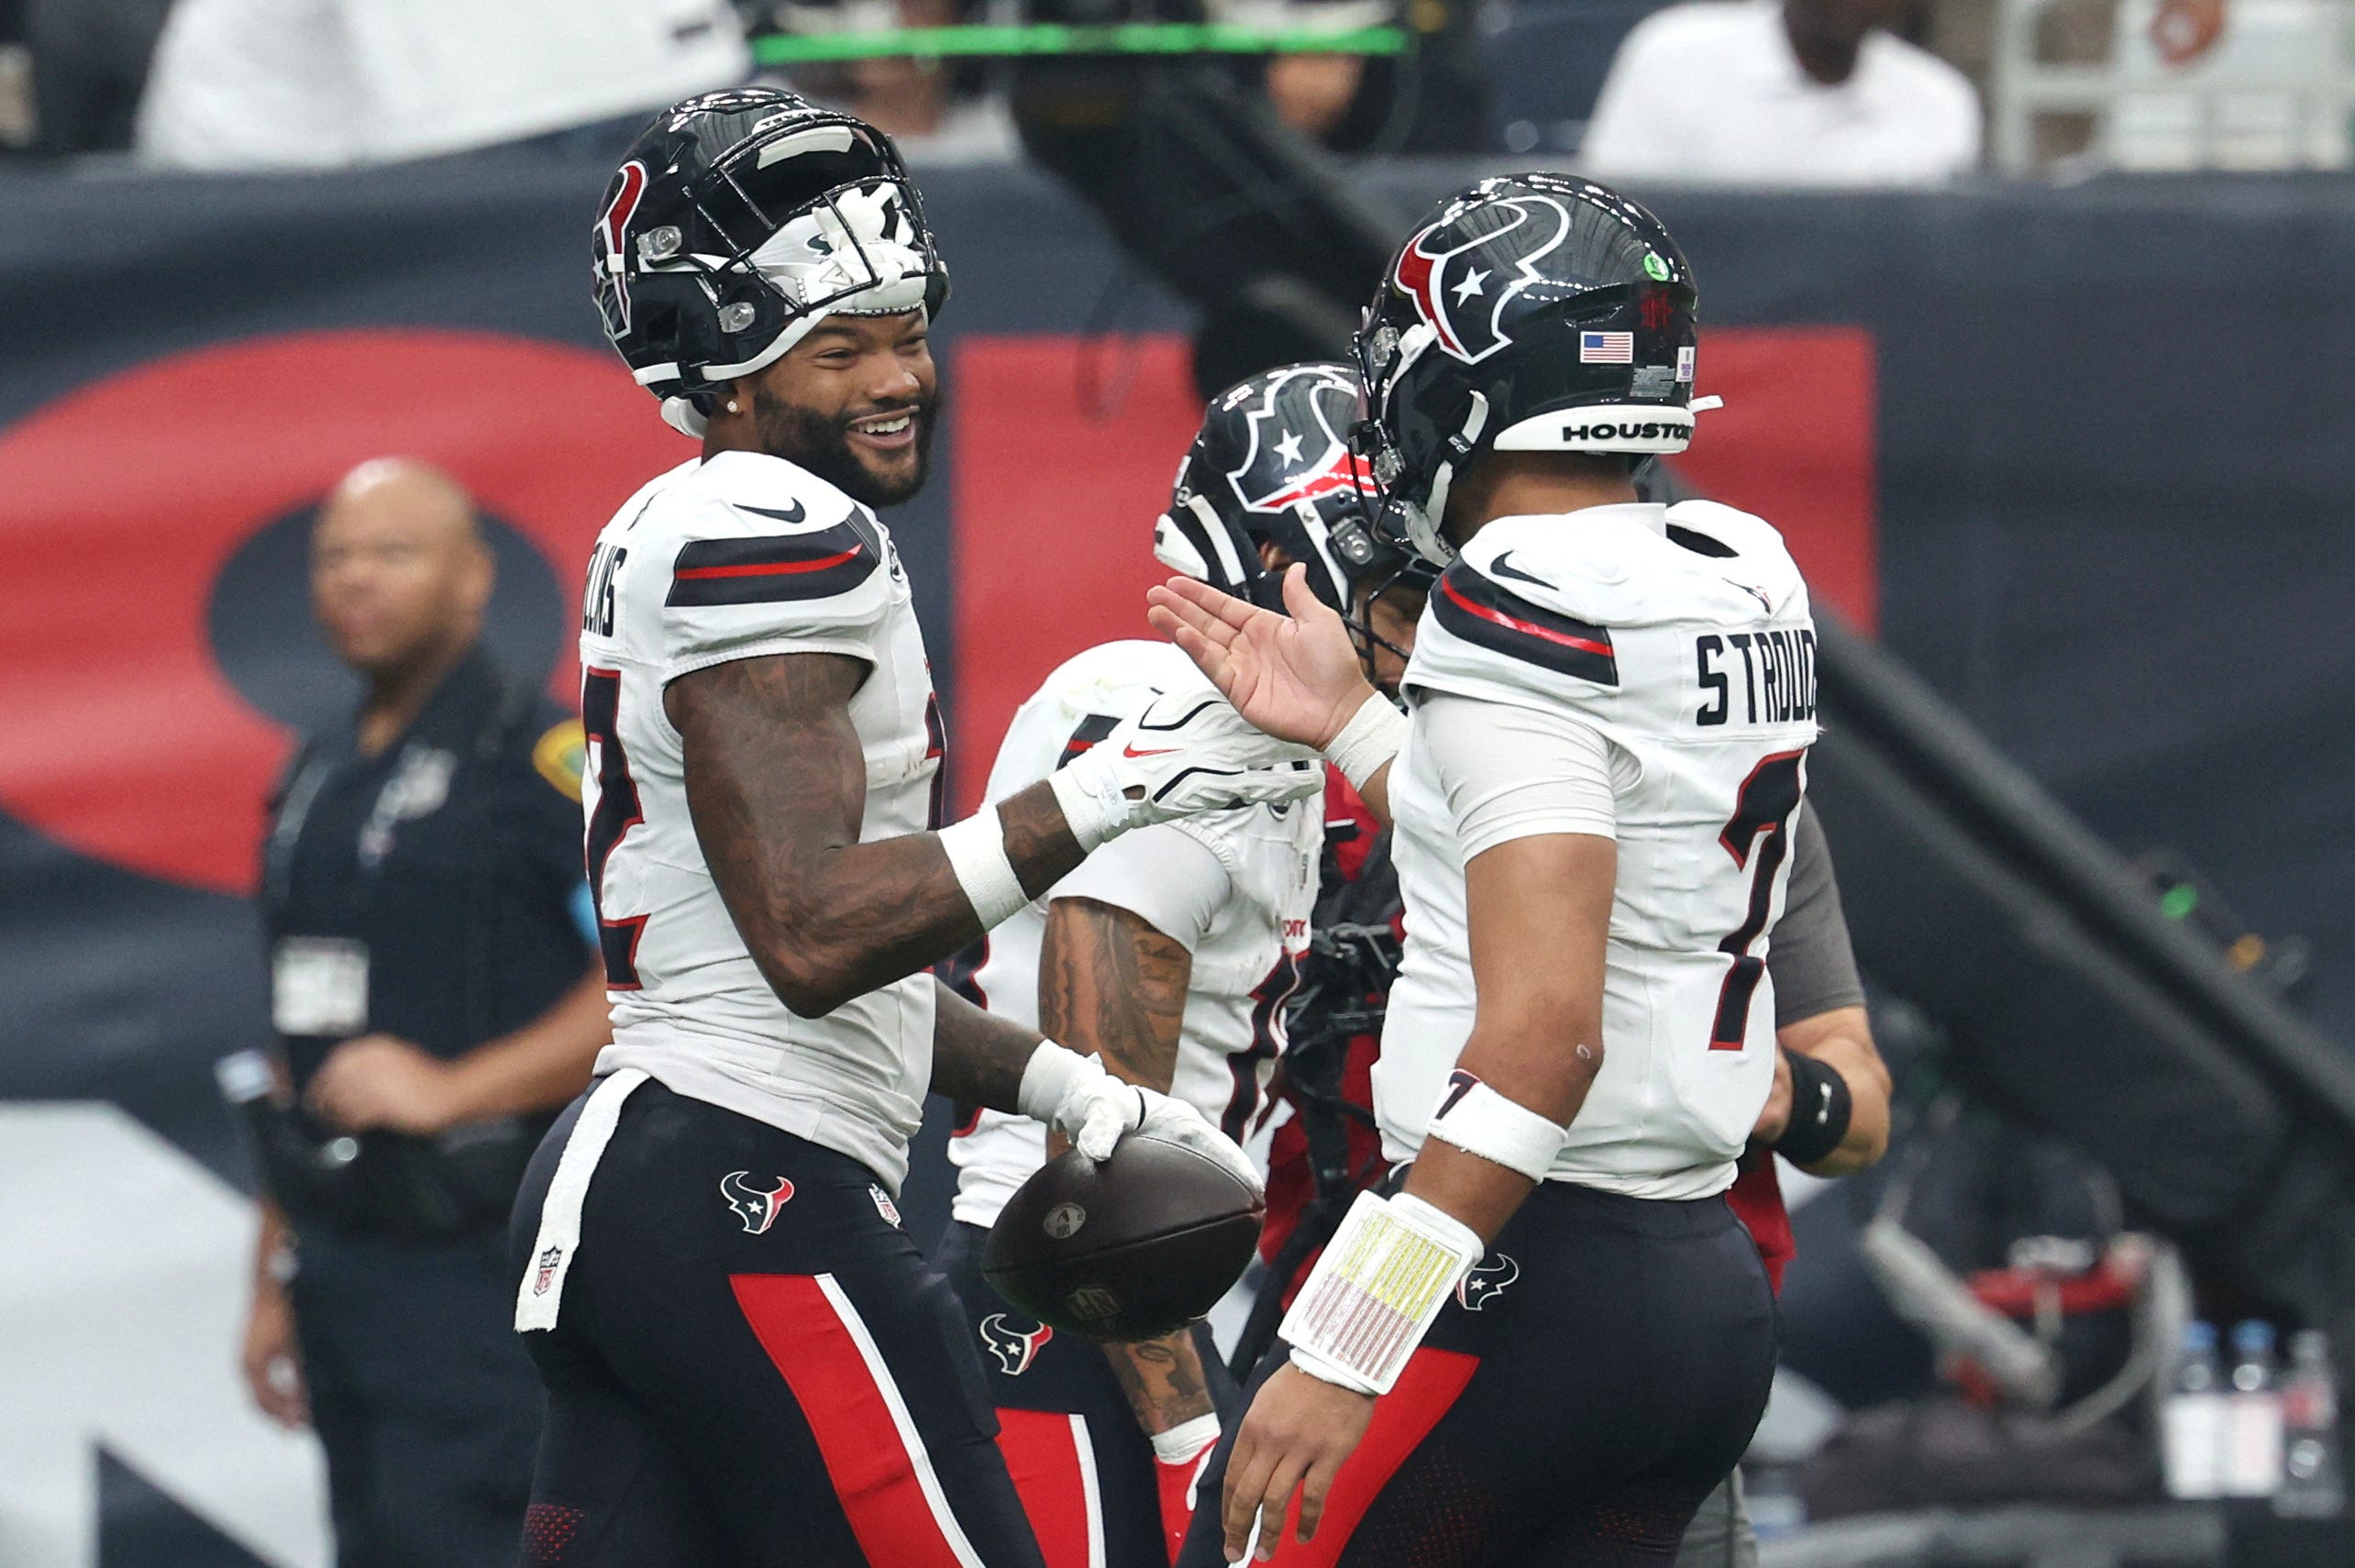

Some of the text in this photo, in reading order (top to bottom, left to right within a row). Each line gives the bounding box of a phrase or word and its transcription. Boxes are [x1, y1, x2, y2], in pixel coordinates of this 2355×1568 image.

[1697, 629, 1818, 727] STROUD
[1708, 749, 1805, 1051] 7
[1434, 1068, 1481, 1121] 7
